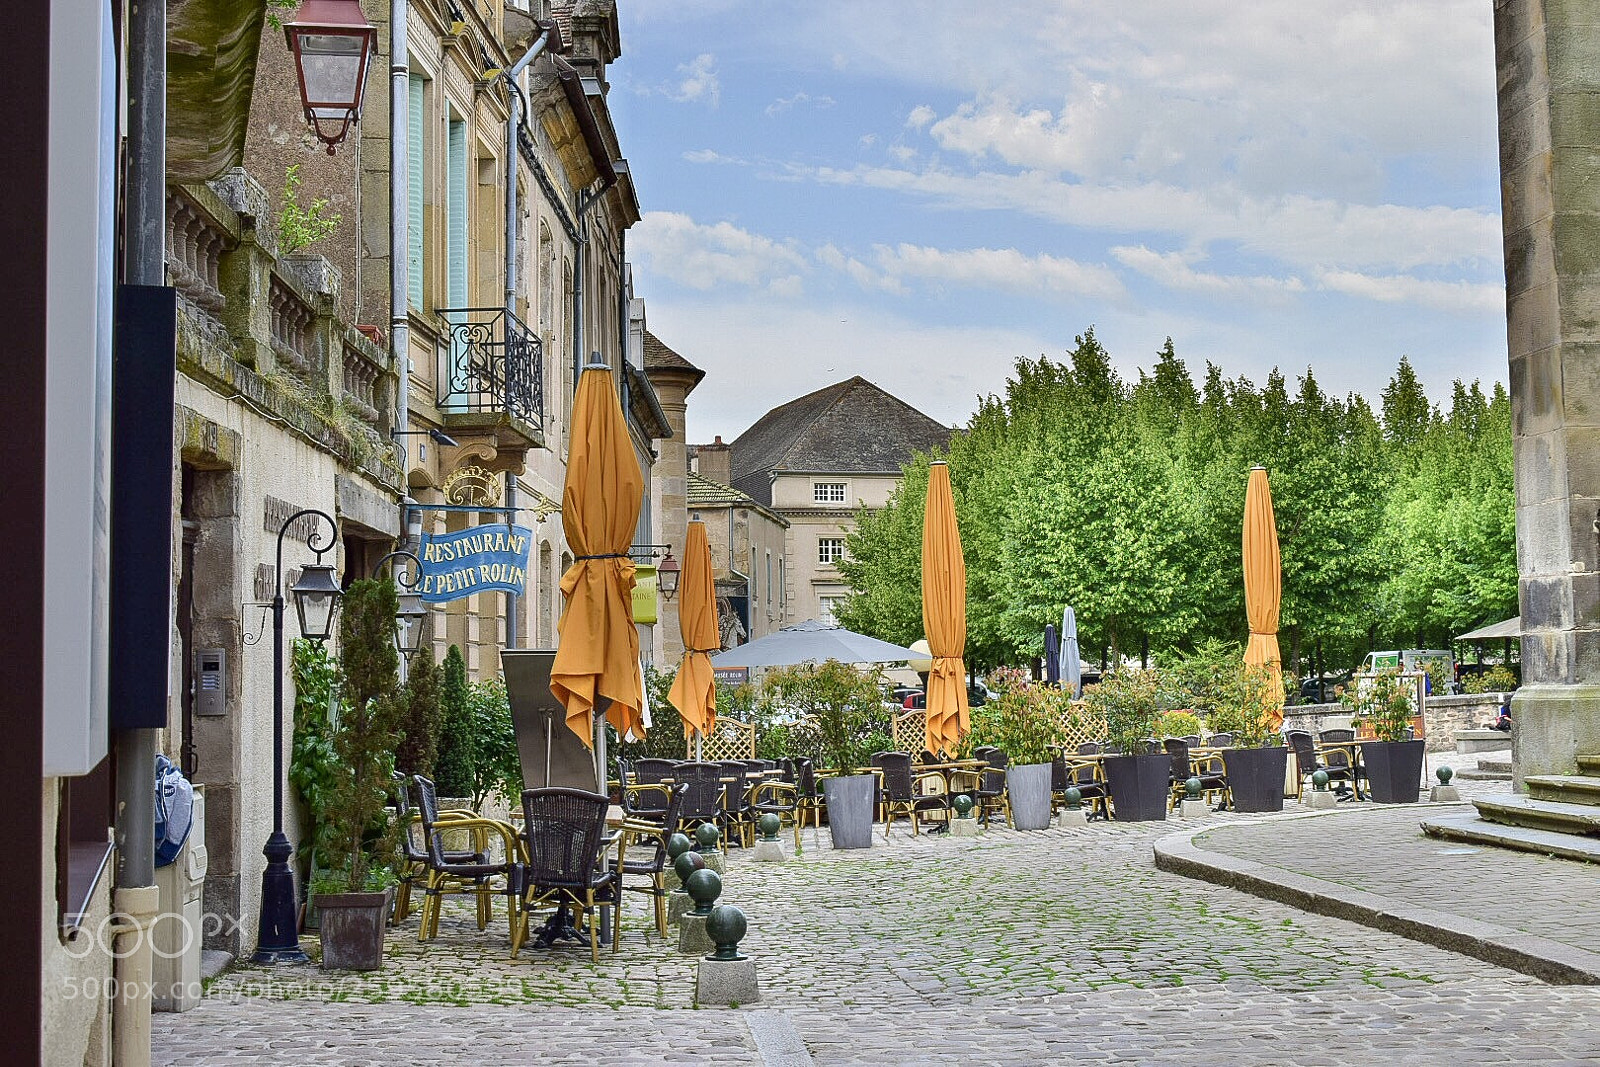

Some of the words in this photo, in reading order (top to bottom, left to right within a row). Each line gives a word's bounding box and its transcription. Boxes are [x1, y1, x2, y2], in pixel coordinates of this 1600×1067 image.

[424, 532, 526, 563] RESTAURANT
[435, 567, 477, 595] PETIT
[478, 563, 525, 586] ROLIN
